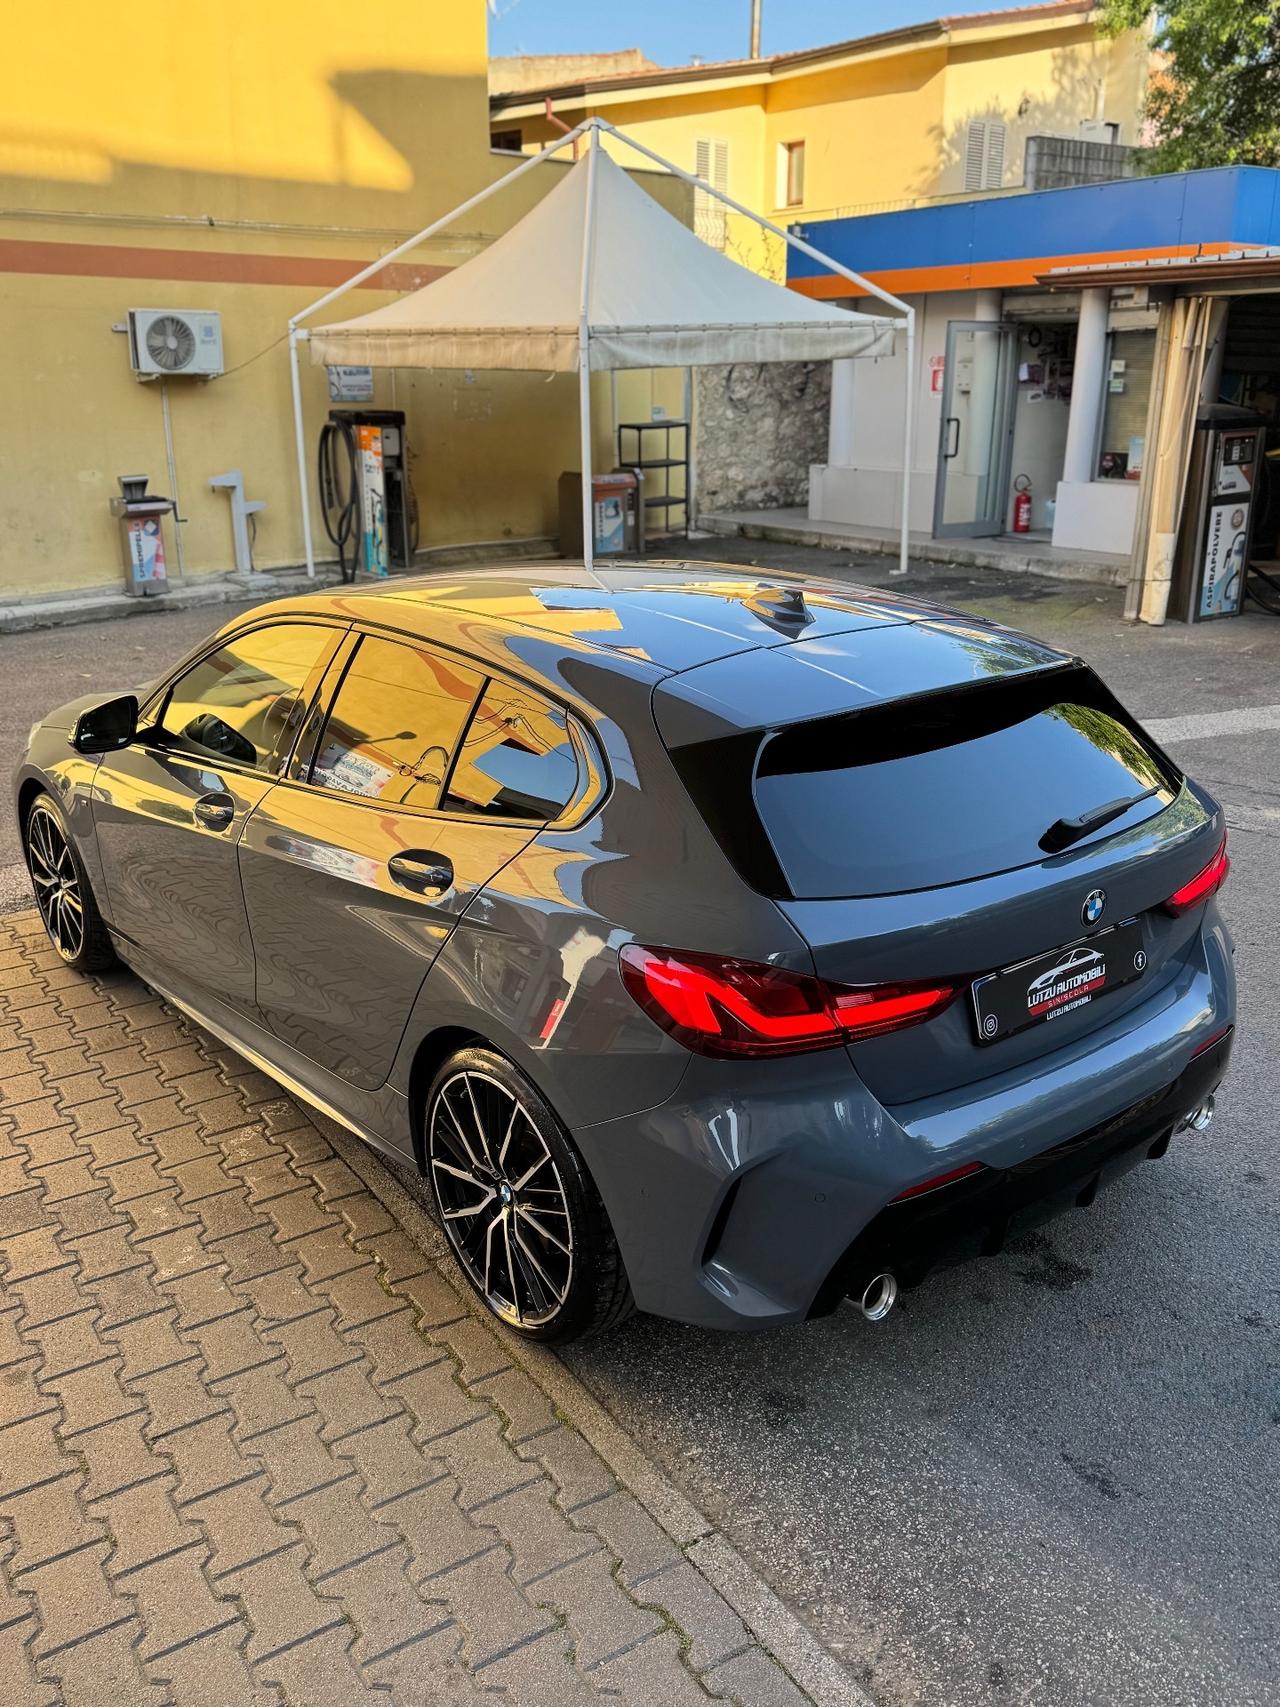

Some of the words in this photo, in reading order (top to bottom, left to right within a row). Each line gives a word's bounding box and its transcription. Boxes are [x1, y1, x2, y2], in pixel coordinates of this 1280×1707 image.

[1206, 511, 1222, 608] ASPIRAPOLVERE
[1028, 984, 1056, 1007] LUTZU
[1057, 963, 1105, 994] AUTOMOBILI
[1048, 985, 1088, 1008] SINISCOLA
[1046, 1007, 1063, 1020] LUTZU
[1064, 994, 1091, 1013] AUTOMOBILI
